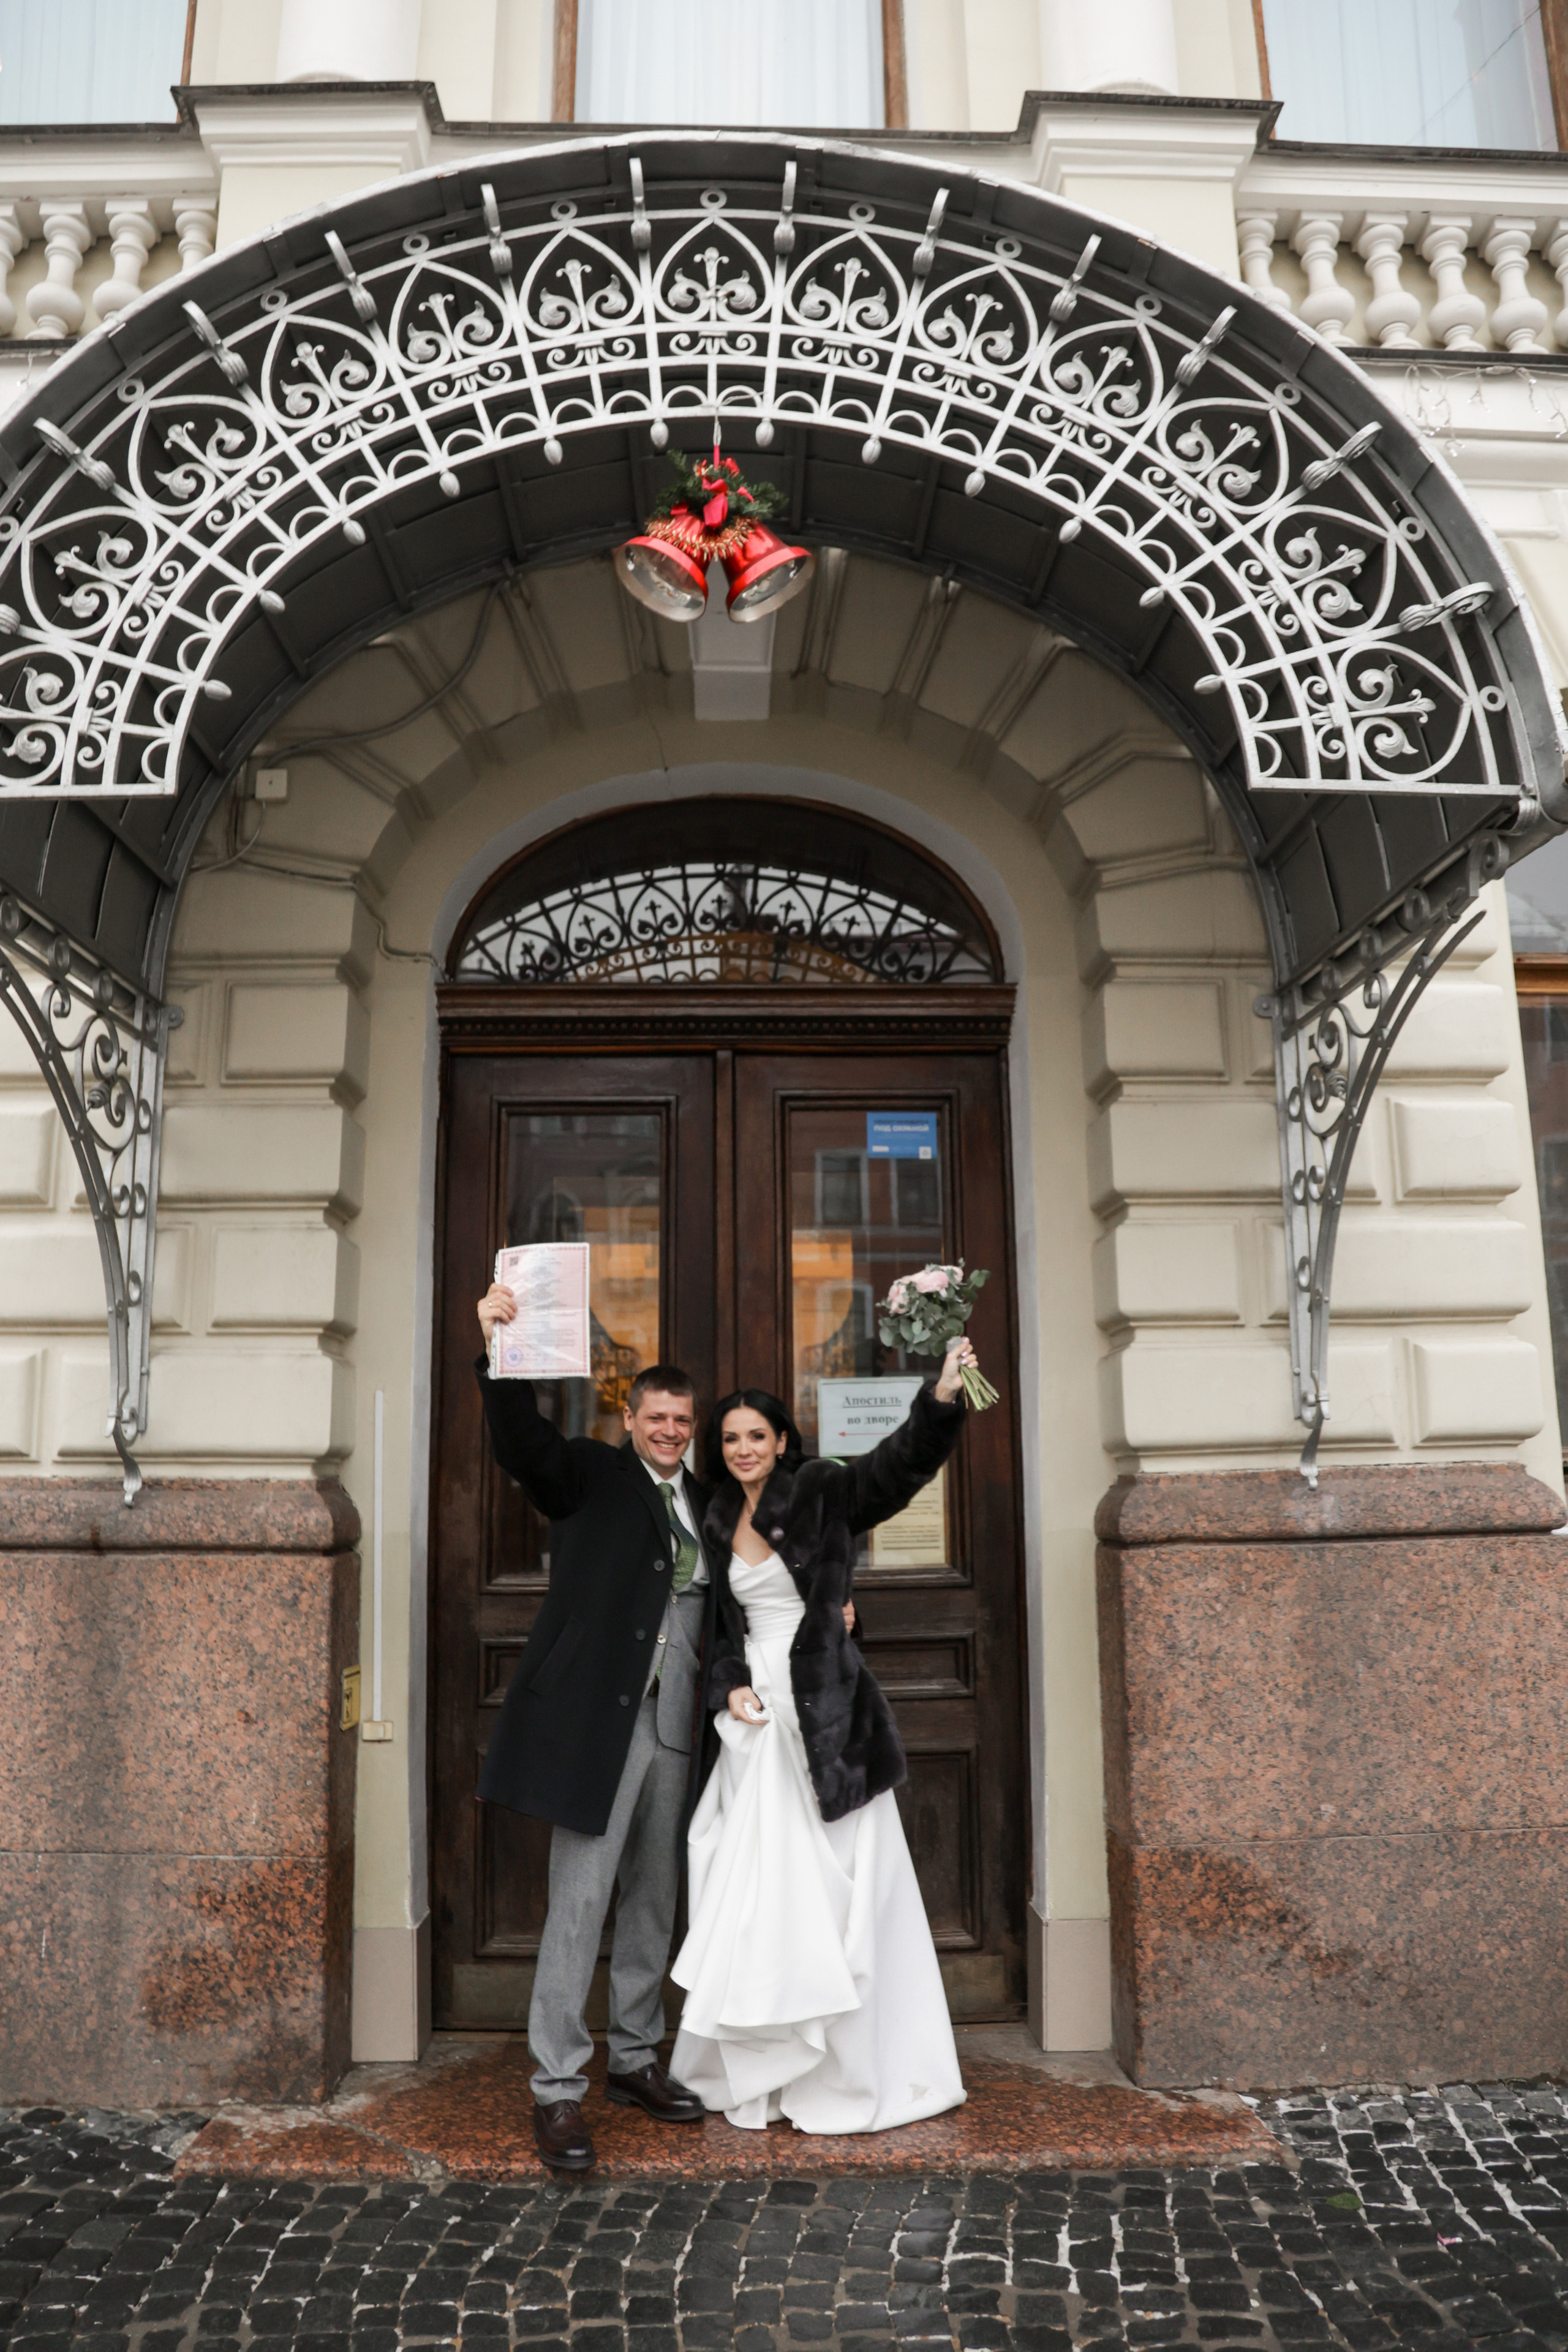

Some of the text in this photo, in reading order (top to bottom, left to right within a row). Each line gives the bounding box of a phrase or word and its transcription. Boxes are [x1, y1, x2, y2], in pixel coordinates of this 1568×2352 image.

[843, 1396, 902, 1407] Апостиль
[847, 1415, 899, 1427] во дворе
